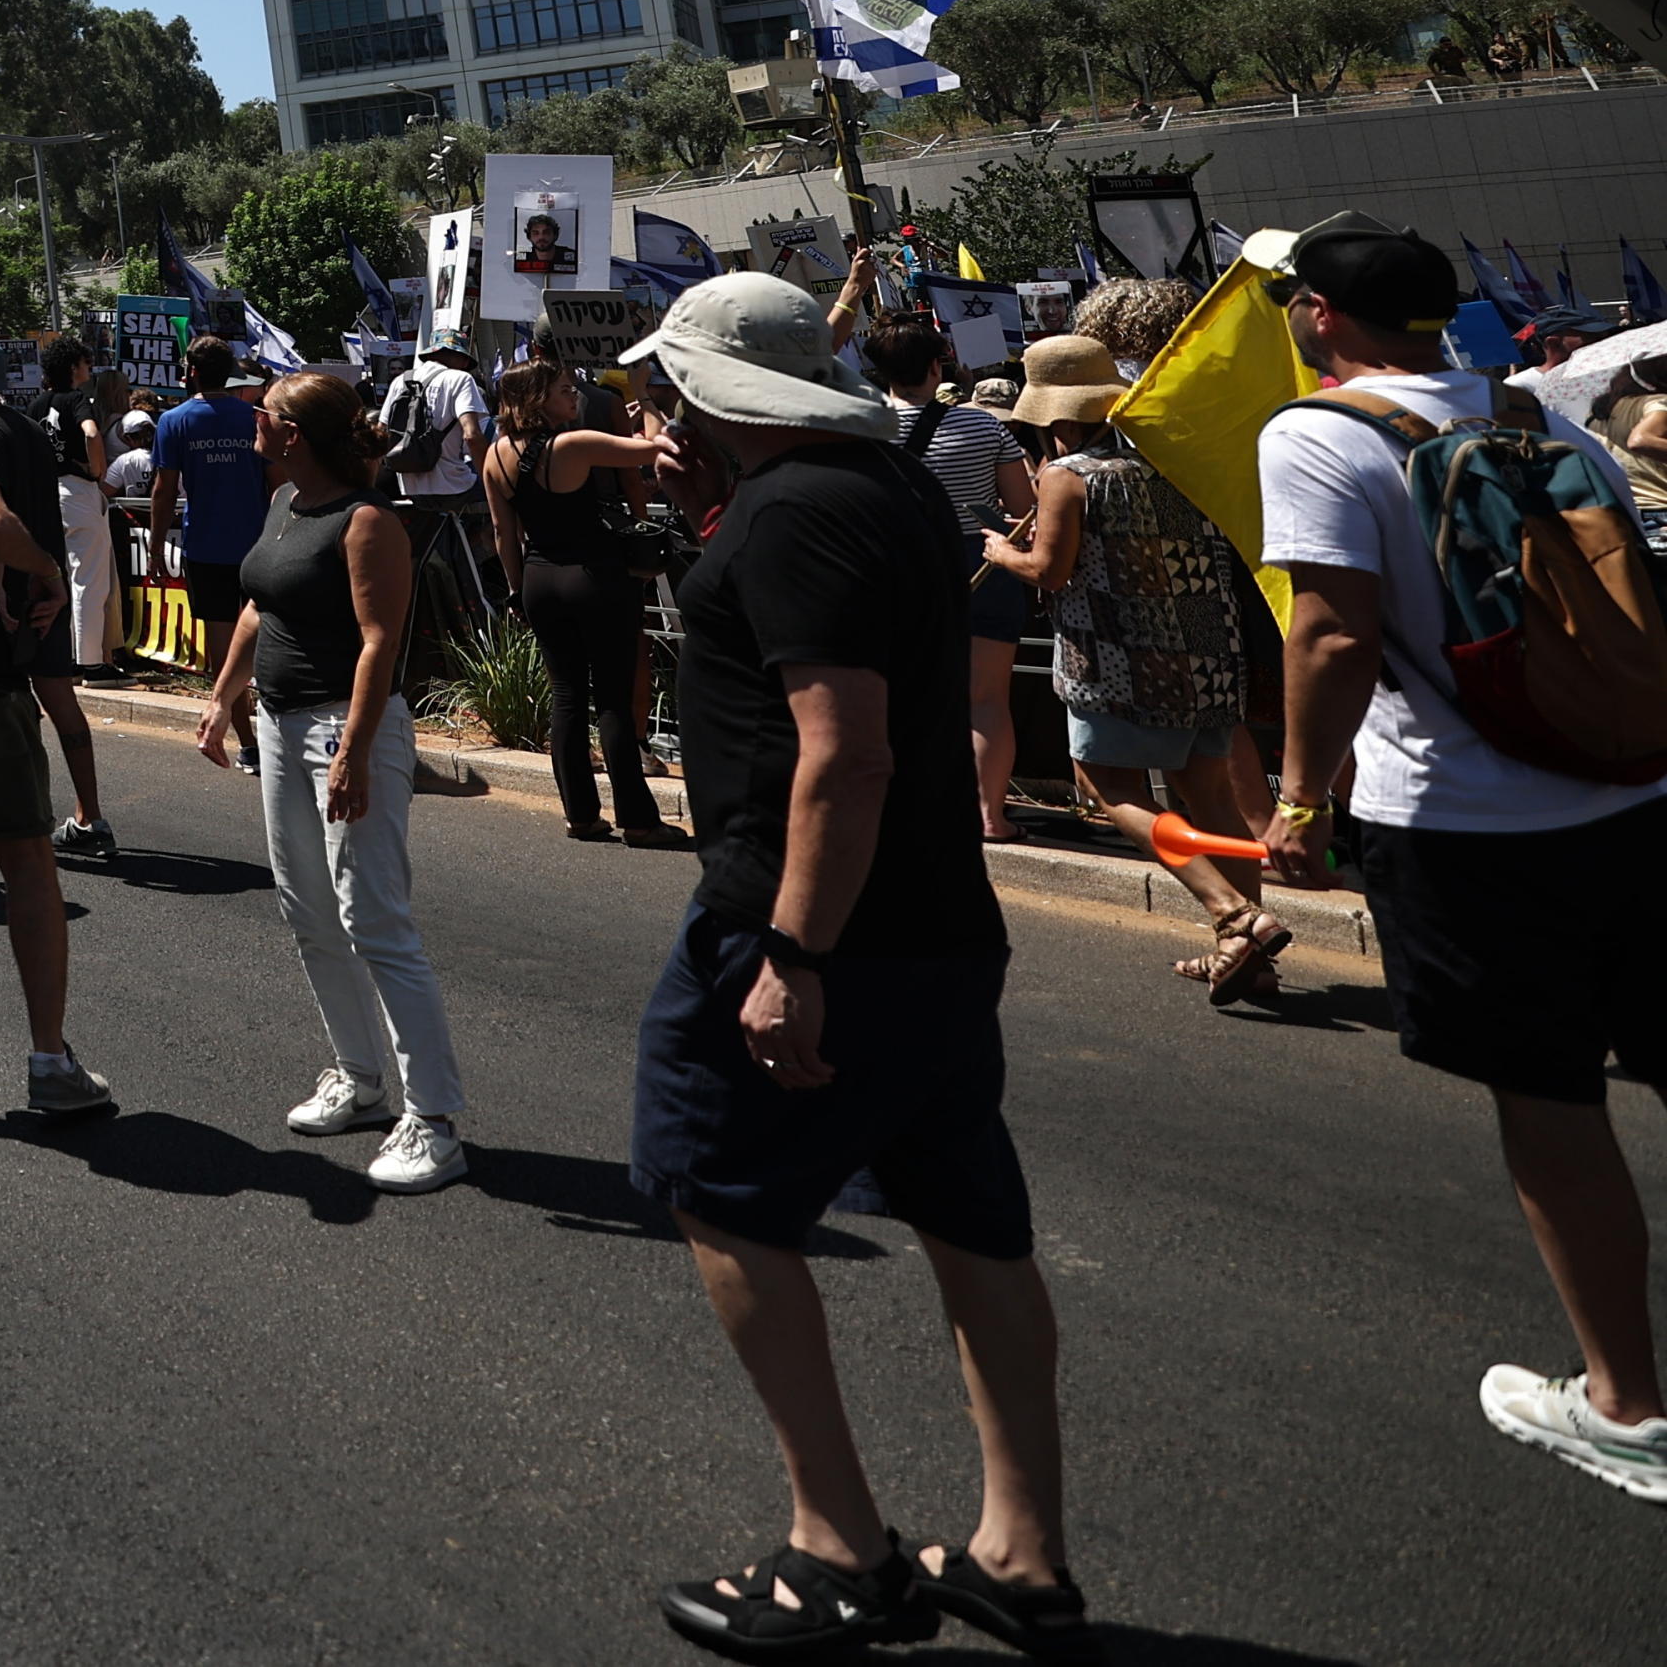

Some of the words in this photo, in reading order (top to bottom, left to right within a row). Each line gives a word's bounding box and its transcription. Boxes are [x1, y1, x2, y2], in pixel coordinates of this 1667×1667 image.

[123, 312, 176, 335] SEA
[551, 300, 625, 327] עסקה
[130, 338, 174, 362] THE
[121, 361, 186, 388] DEAL
[187, 437, 216, 450] JUDO
[216, 437, 254, 450] COACH
[205, 452, 236, 464] BAM!
